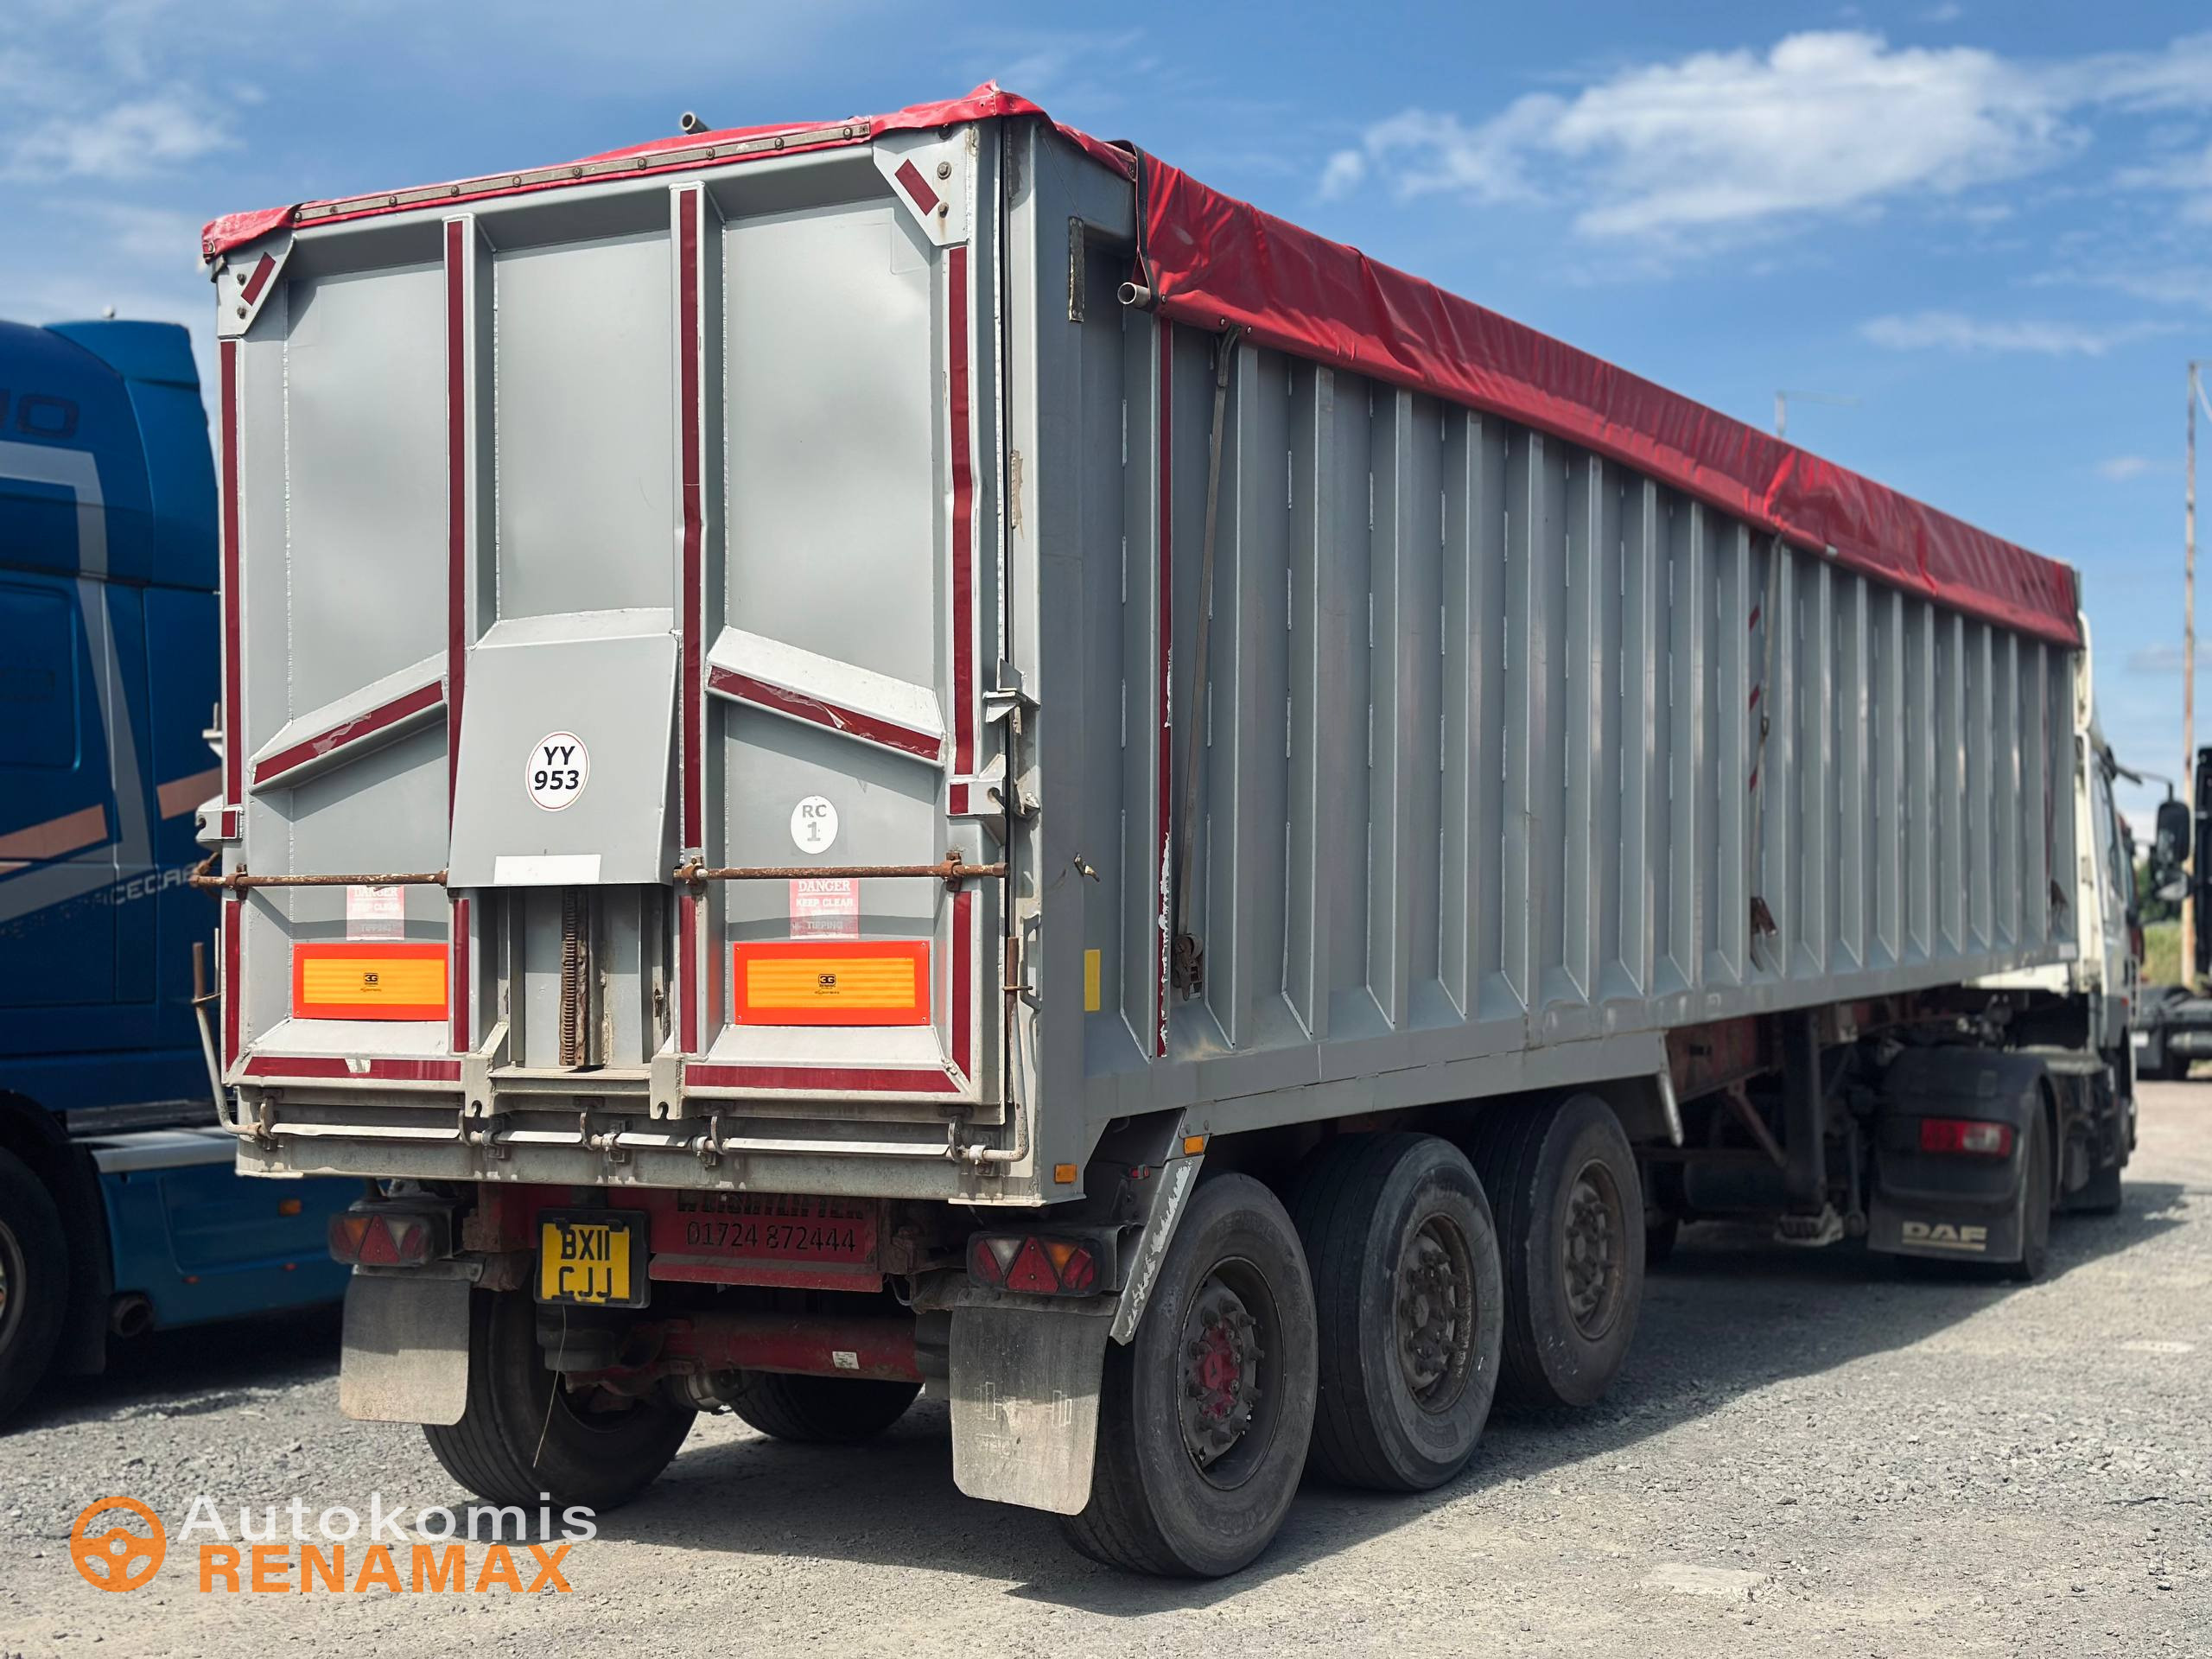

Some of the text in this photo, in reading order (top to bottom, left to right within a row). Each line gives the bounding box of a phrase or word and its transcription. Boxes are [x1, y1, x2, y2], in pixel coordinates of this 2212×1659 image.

[543, 746, 576, 766] YY
[533, 769, 580, 791] 953
[802, 804, 827, 818] RC
[806, 822, 821, 842] 1
[798, 880, 851, 893] DANGER
[796, 898, 854, 908] KEEP CLEAR
[687, 1221, 856, 1253] 01724 872444
[1903, 1220, 1987, 1243] DAF
[558, 1266, 613, 1298] CJJ
